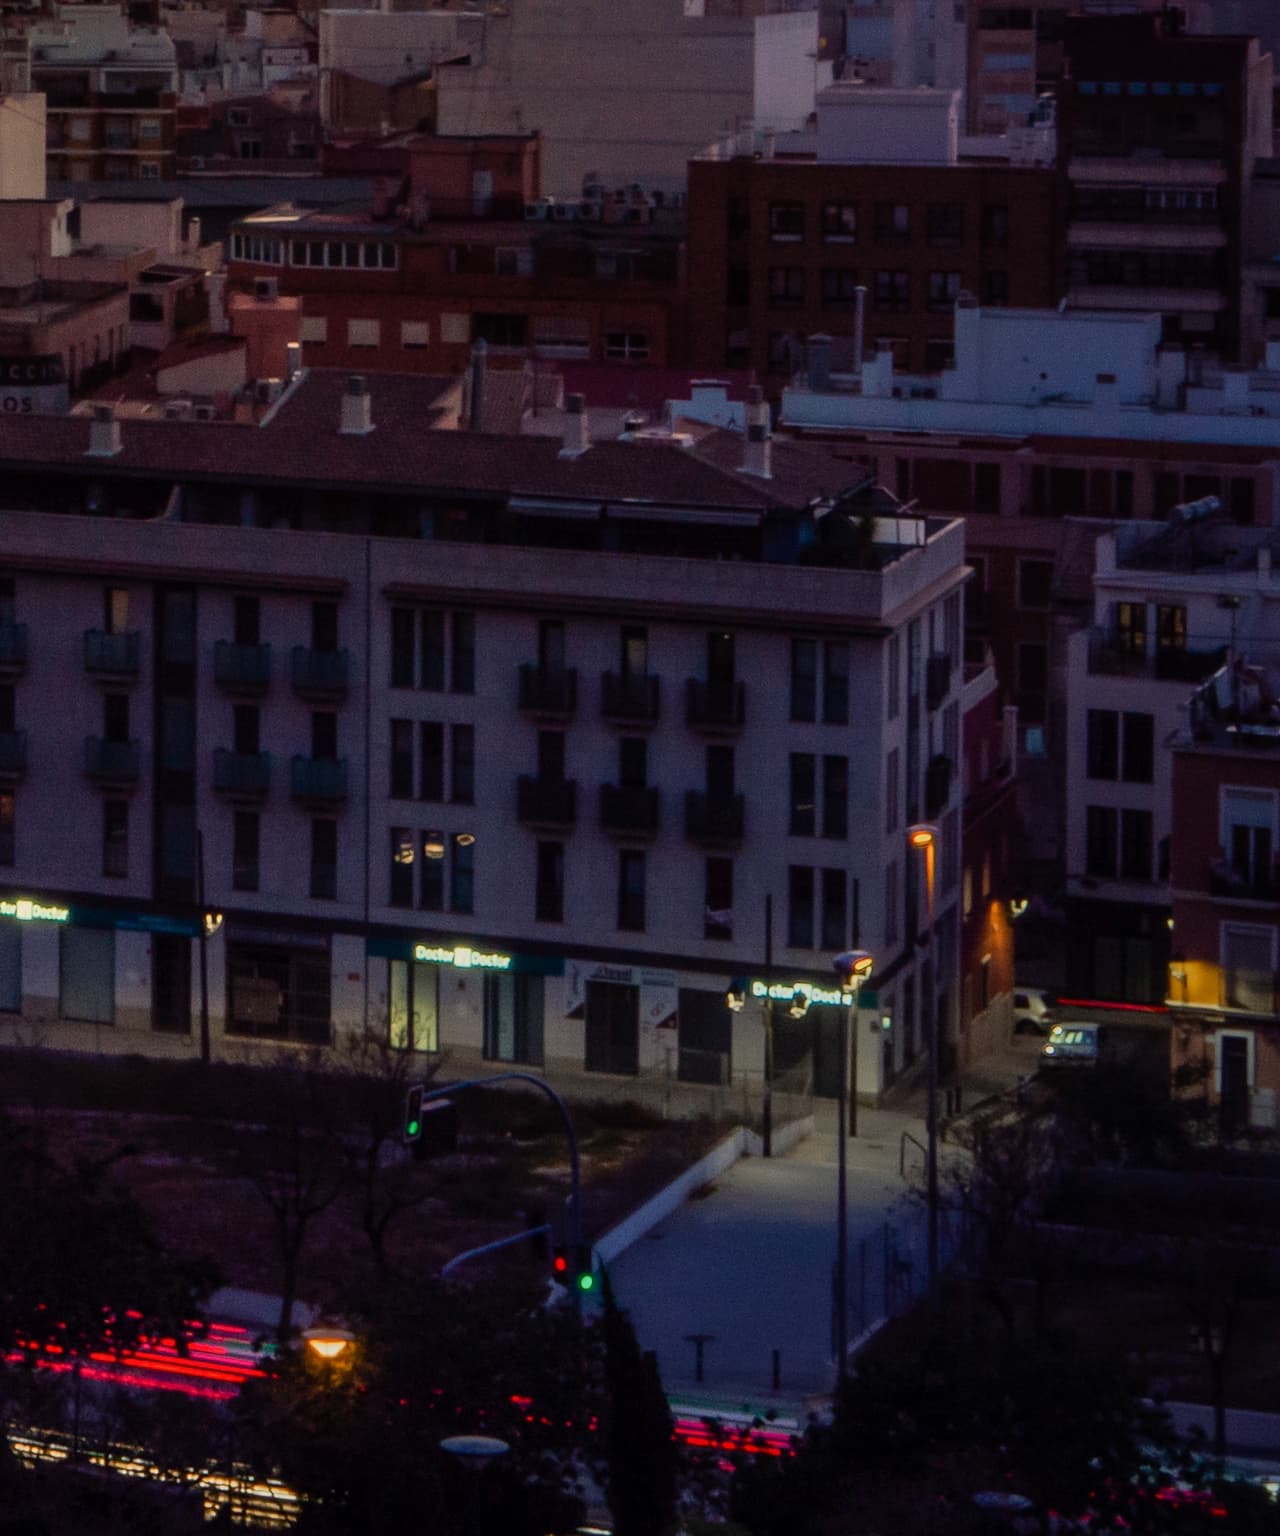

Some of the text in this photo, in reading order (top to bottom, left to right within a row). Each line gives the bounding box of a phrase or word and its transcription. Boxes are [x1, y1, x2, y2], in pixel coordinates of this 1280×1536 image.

[31, 904, 69, 920] Doctor
[415, 945, 511, 969] Doctor Doctor
